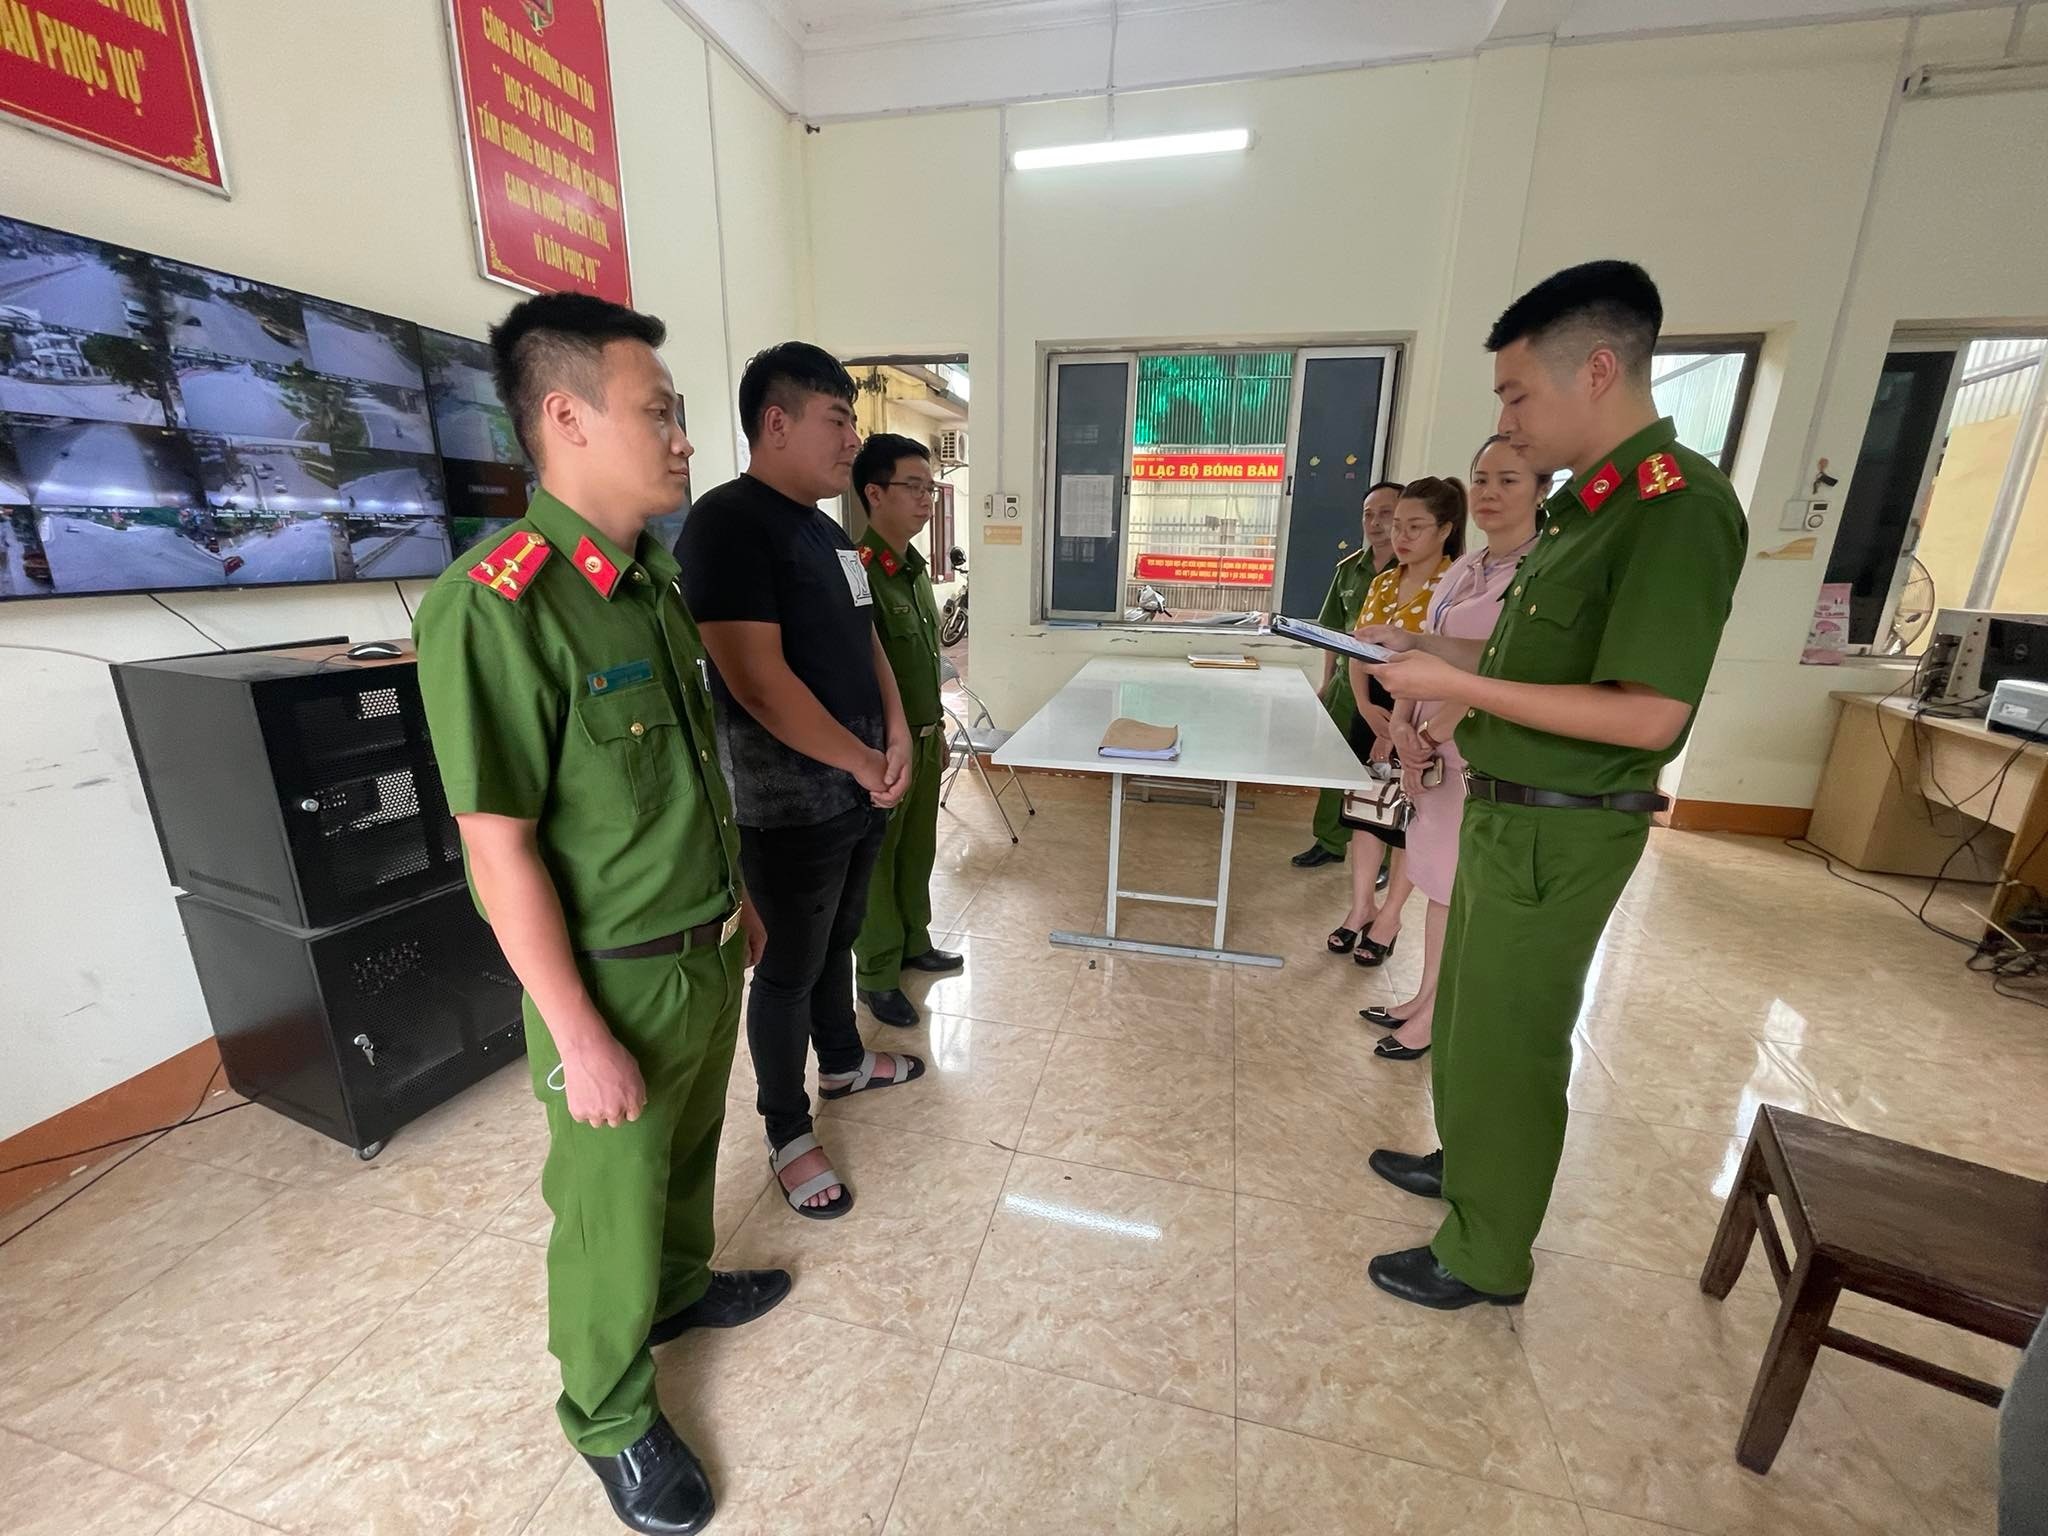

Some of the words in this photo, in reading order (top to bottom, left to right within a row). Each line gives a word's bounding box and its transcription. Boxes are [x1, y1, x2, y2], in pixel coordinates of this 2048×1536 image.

[37, 11, 109, 97] PHỤC
[481, 5, 510, 54] CÔNG
[511, 27, 526, 65] AN
[501, 119, 534, 165] GƯƠNG
[533, 138, 553, 179] ĐẠO
[524, 83, 541, 127] TẬP
[541, 95, 556, 132] VÀ
[574, 118, 595, 155] THEO
[543, 234, 564, 271] DÂN
[562, 245, 585, 283] PHỤC
[1149, 464, 1176, 479] LẠC
[1179, 462, 1199, 479] BỘ
[1202, 463, 1243, 477] BÓNG
